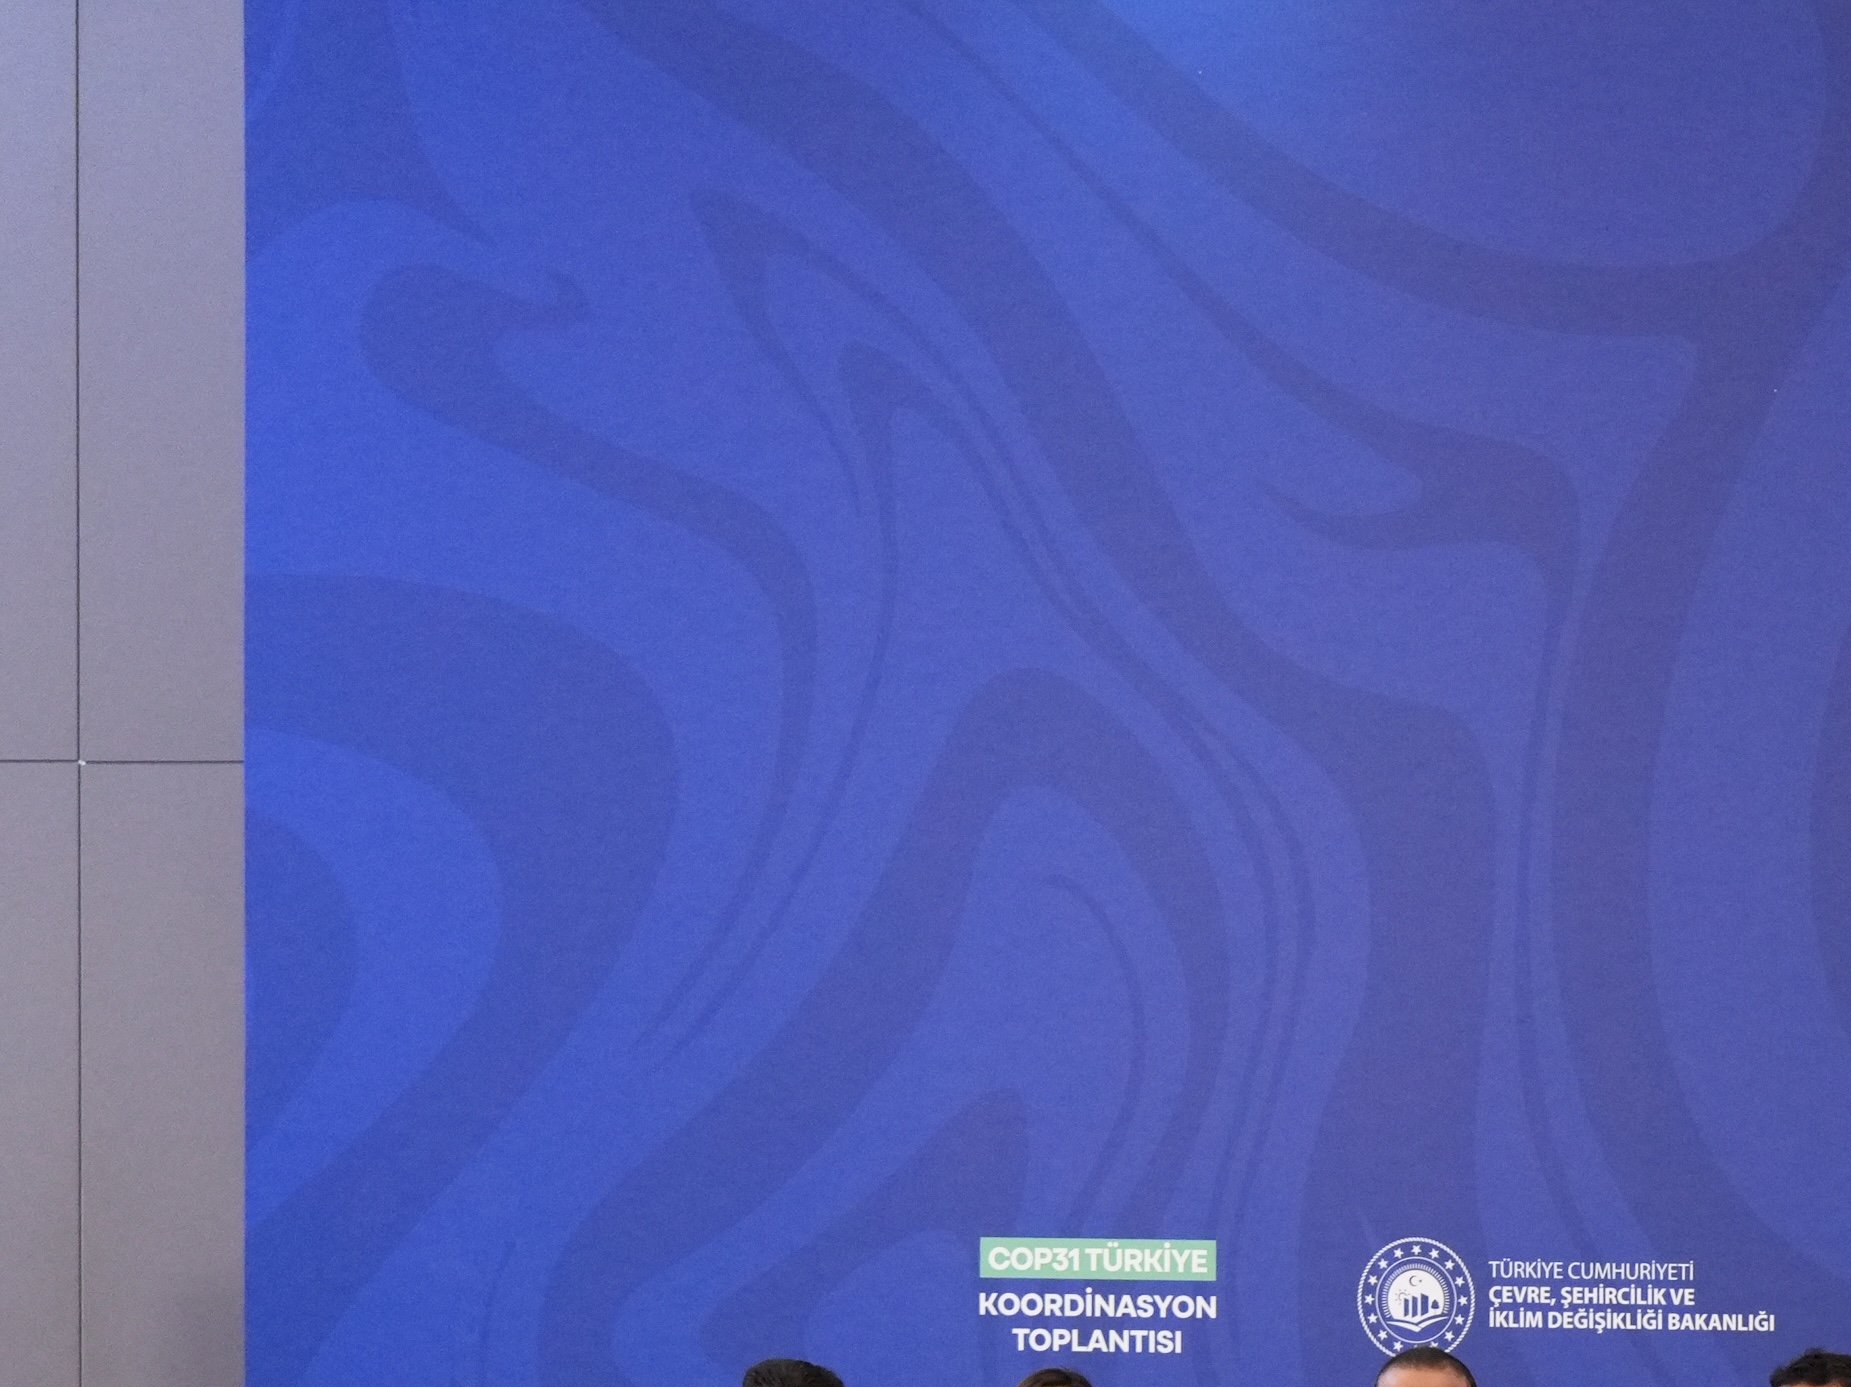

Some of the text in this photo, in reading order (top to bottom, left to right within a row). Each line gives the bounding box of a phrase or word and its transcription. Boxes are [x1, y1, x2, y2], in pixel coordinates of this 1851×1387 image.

[989, 1242, 1207, 1273] COP31 TÜRKİYE
[1488, 1258, 1693, 1280] TÜRKİYE CUMHURİYETİ
[980, 1287, 1216, 1318] KOORDİNASYON
[1489, 1284, 1695, 1308] ÇEVRE, ŞEHİRCİLİK VE
[1490, 1308, 1774, 1333] İKLİM DEĞİŞİKLİĞİ BAKANLIĞI
[1012, 1328, 1181, 1353] TOPLANTISI
